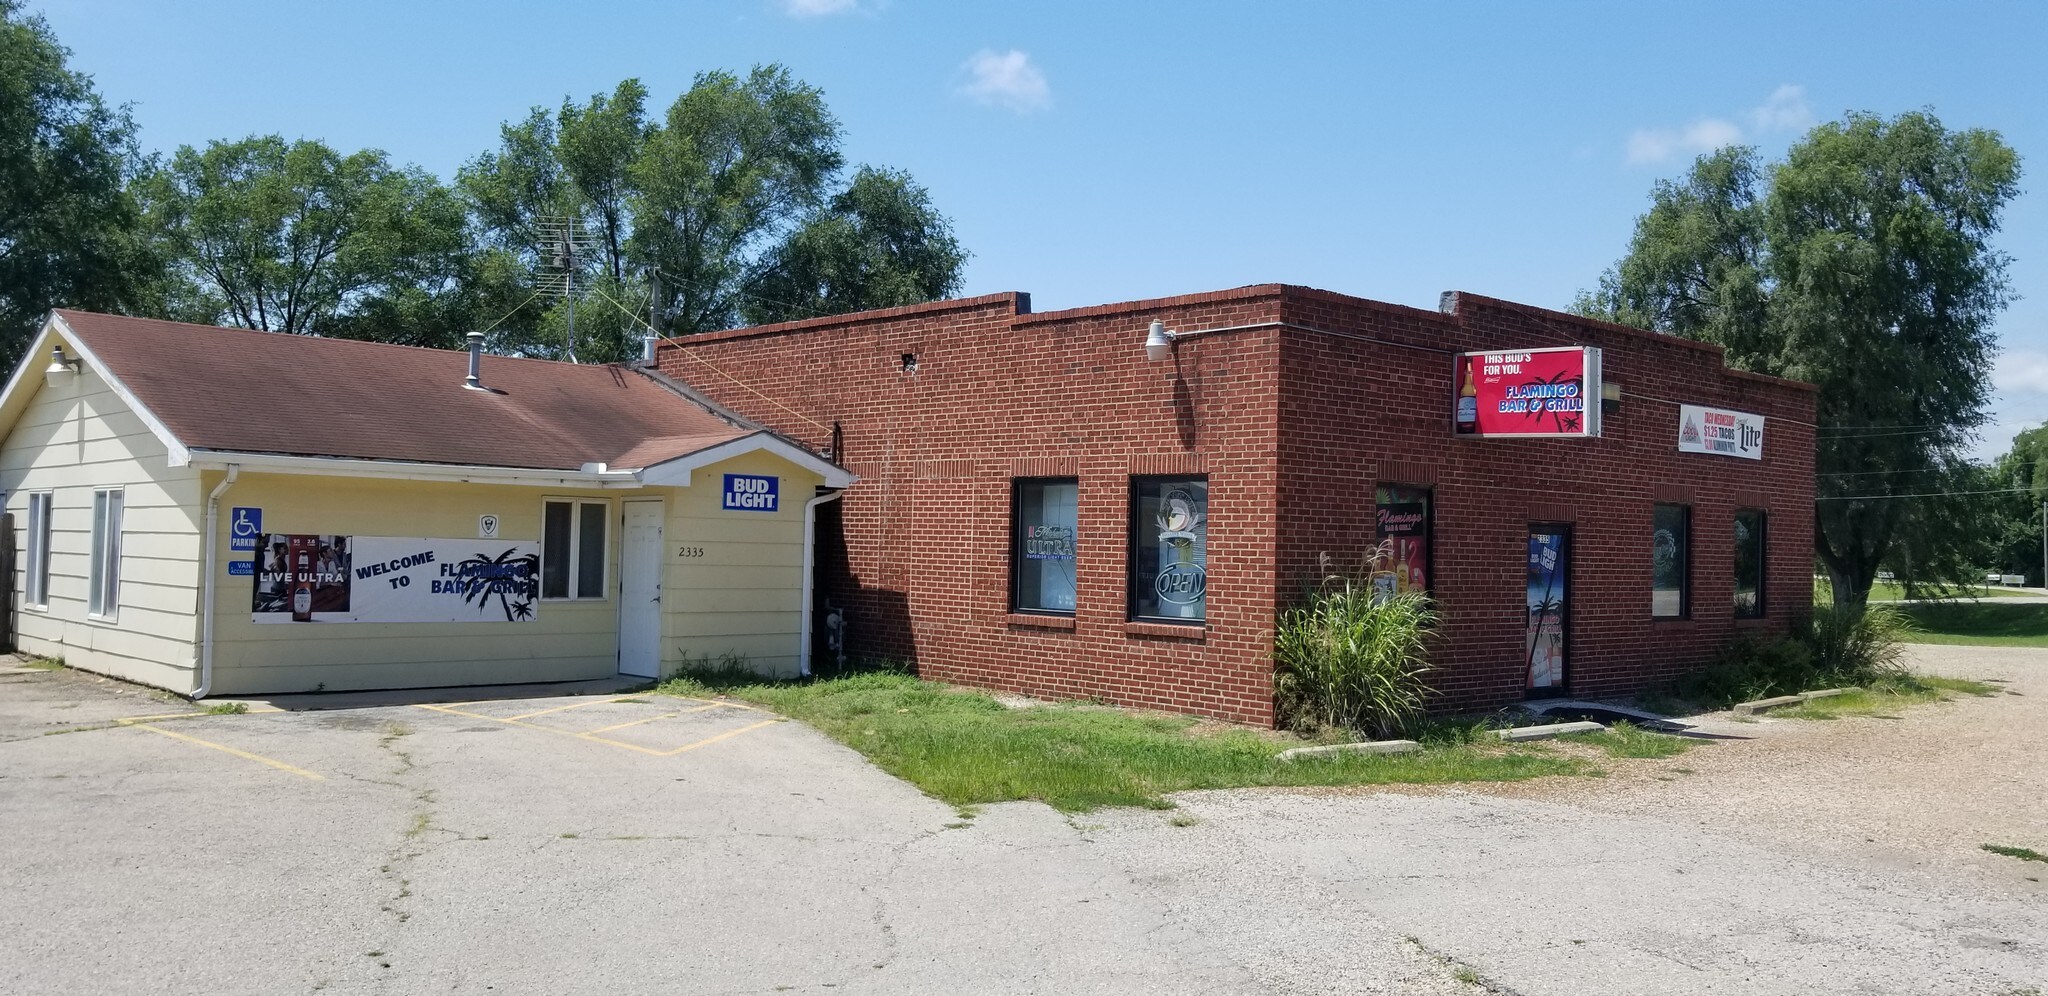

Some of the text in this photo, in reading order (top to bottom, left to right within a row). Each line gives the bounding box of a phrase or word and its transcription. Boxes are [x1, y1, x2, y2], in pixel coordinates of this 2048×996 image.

[1483, 353, 1532, 364] THIS BUD'S
[1483, 364, 1522, 375] FOR YOU.
[1506, 384, 1578, 399] FLAMINGO
[1498, 398, 1583, 413] BAR & GRILL
[1704, 425, 1735, 440] $1.25 TACOS
[1740, 423, 1761, 453] Lite
[733, 478, 769, 494] BUD
[726, 492, 776, 508] LIGHT
[1376, 508, 1423, 527] Flamingo
[232, 538, 256, 547] PARKIN
[1026, 539, 1072, 555] ULTRA
[678, 546, 704, 558] 2335
[1543, 546, 1557, 561] BUD
[355, 550, 436, 580] WELCOME
[1540, 554, 1555, 571] LIGH
[260, 573, 344, 583] LIVE ULTRA
[440, 563, 529, 578] FLAMINGO
[389, 575, 411, 590] TO
[431, 580, 466, 594] BAR
[1158, 573, 1204, 593] OPEN
